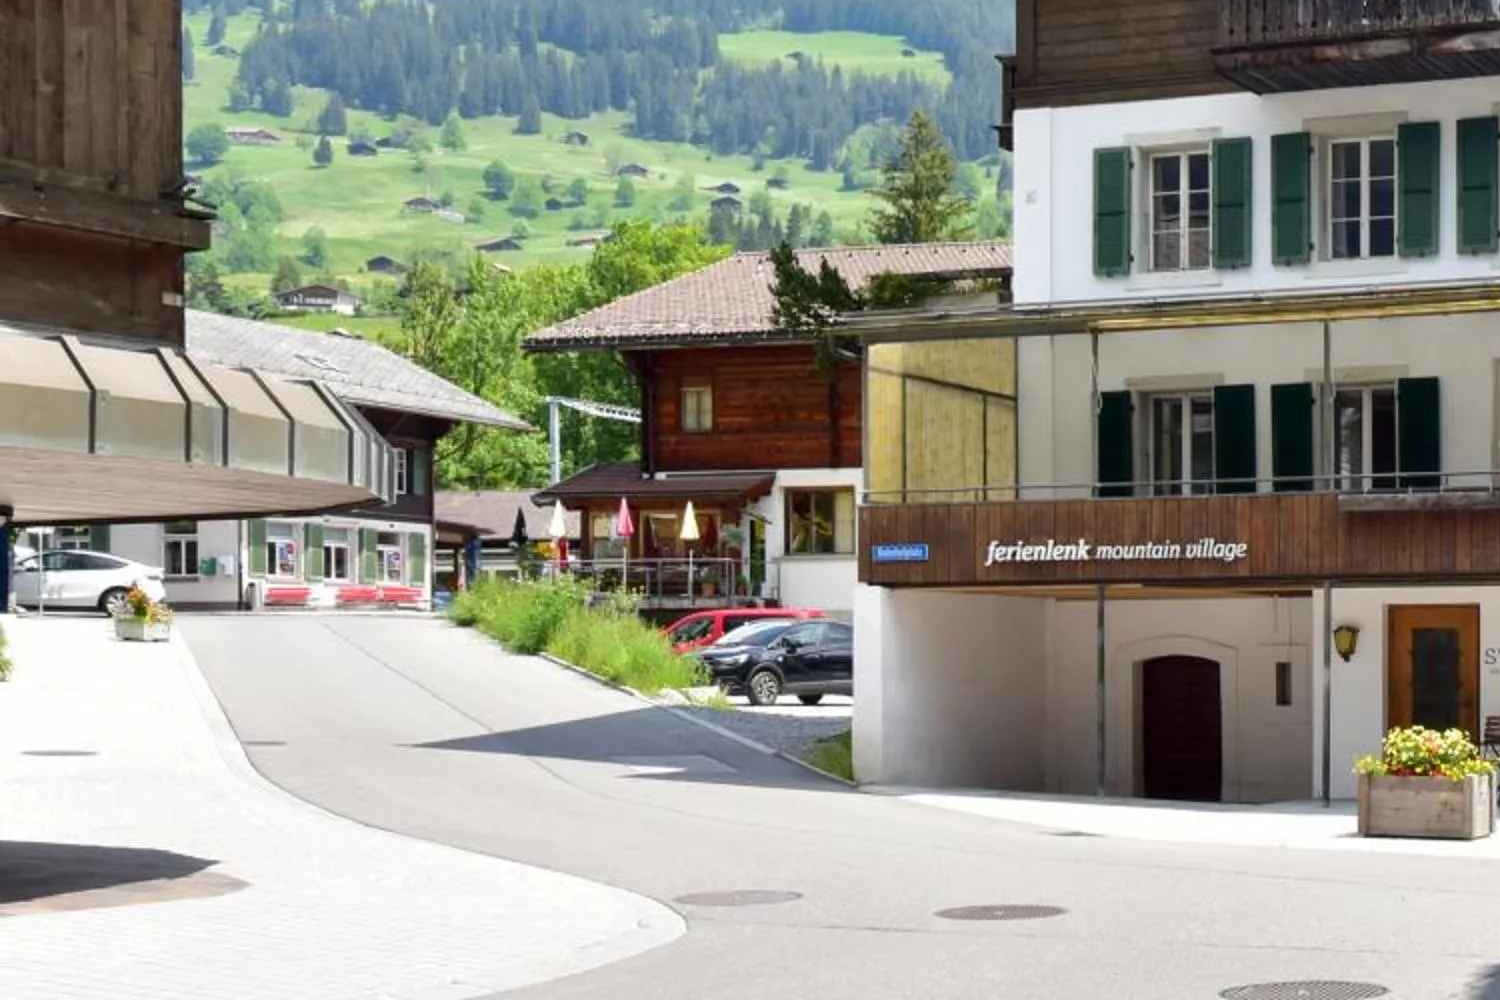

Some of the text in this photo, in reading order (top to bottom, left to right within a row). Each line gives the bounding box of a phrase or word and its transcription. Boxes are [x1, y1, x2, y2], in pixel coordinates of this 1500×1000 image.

[984, 537, 1248, 567] ferienlenk mountain village
